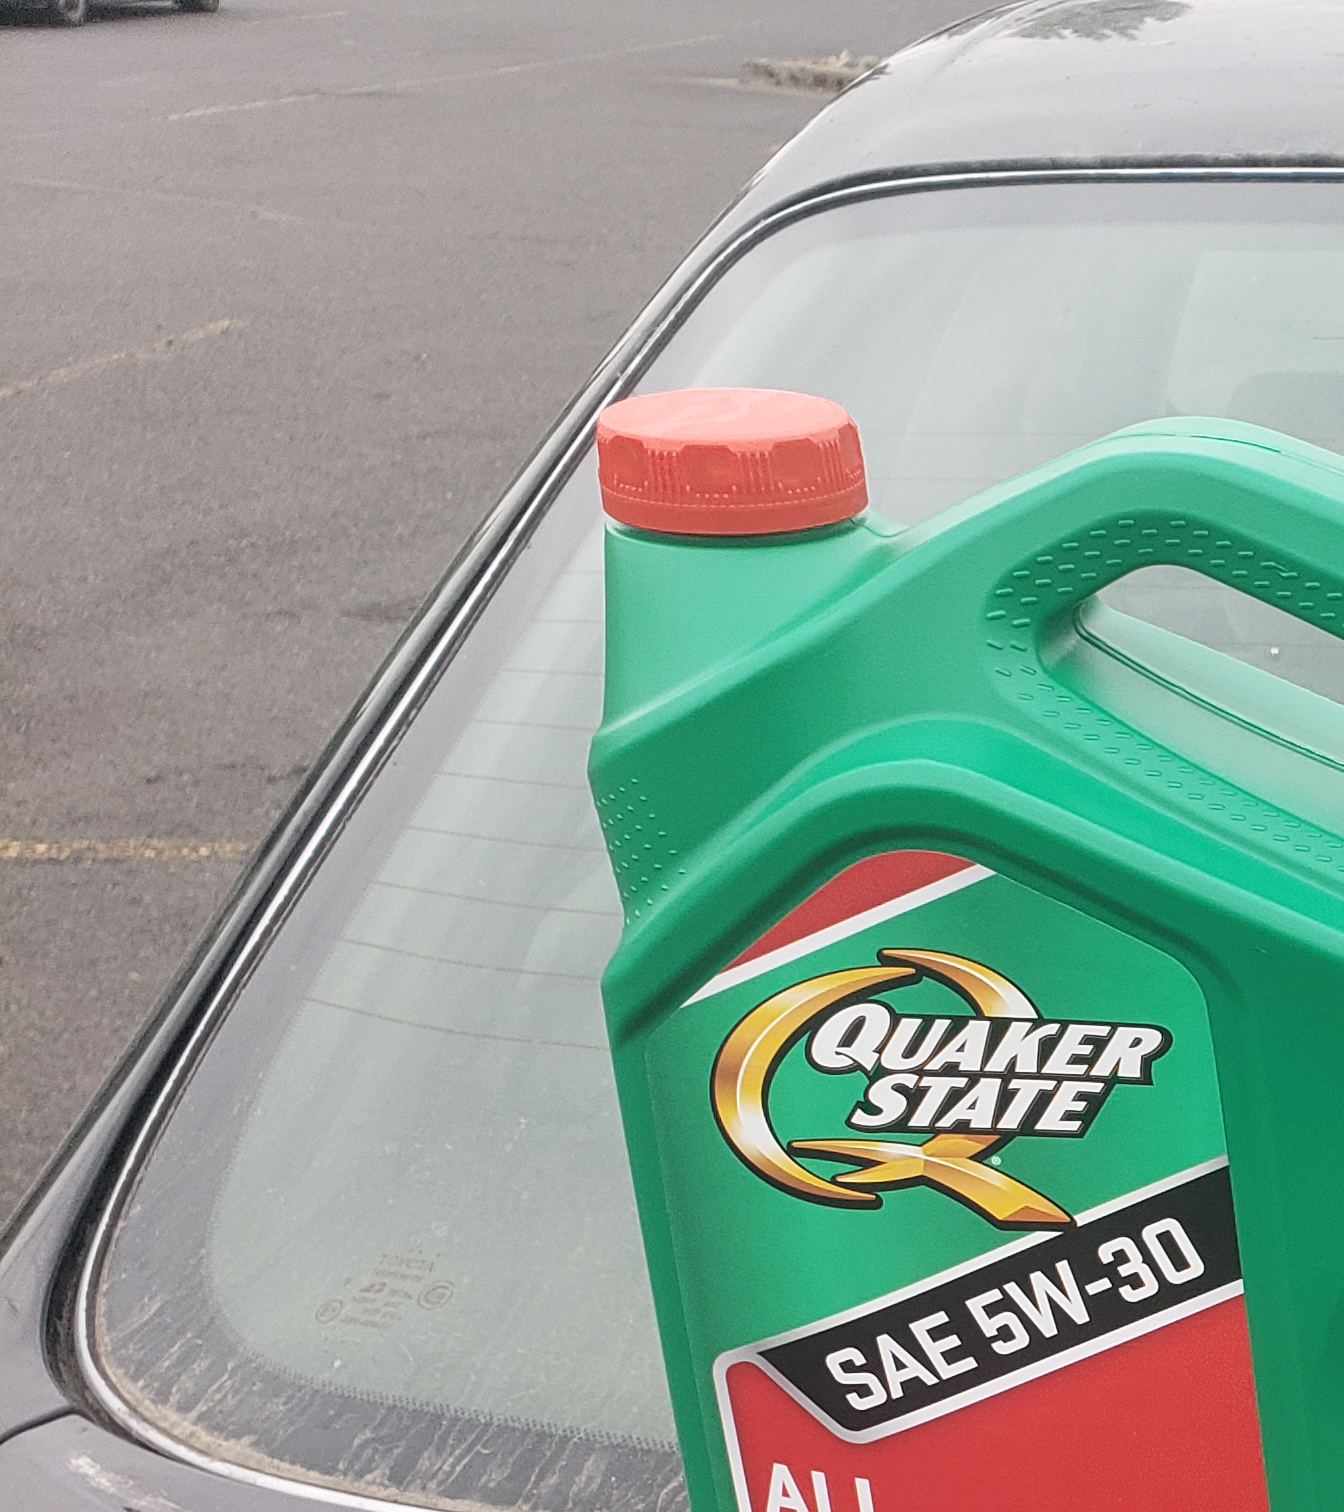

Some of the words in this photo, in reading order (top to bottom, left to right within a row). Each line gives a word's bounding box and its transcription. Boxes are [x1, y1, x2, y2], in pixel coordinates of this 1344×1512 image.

[809, 1001, 1164, 1079] QUAKER
[849, 1073, 1106, 1133] STATE
[825, 1310, 979, 1411] SAE
[964, 1217, 1205, 1356] 5W-30
